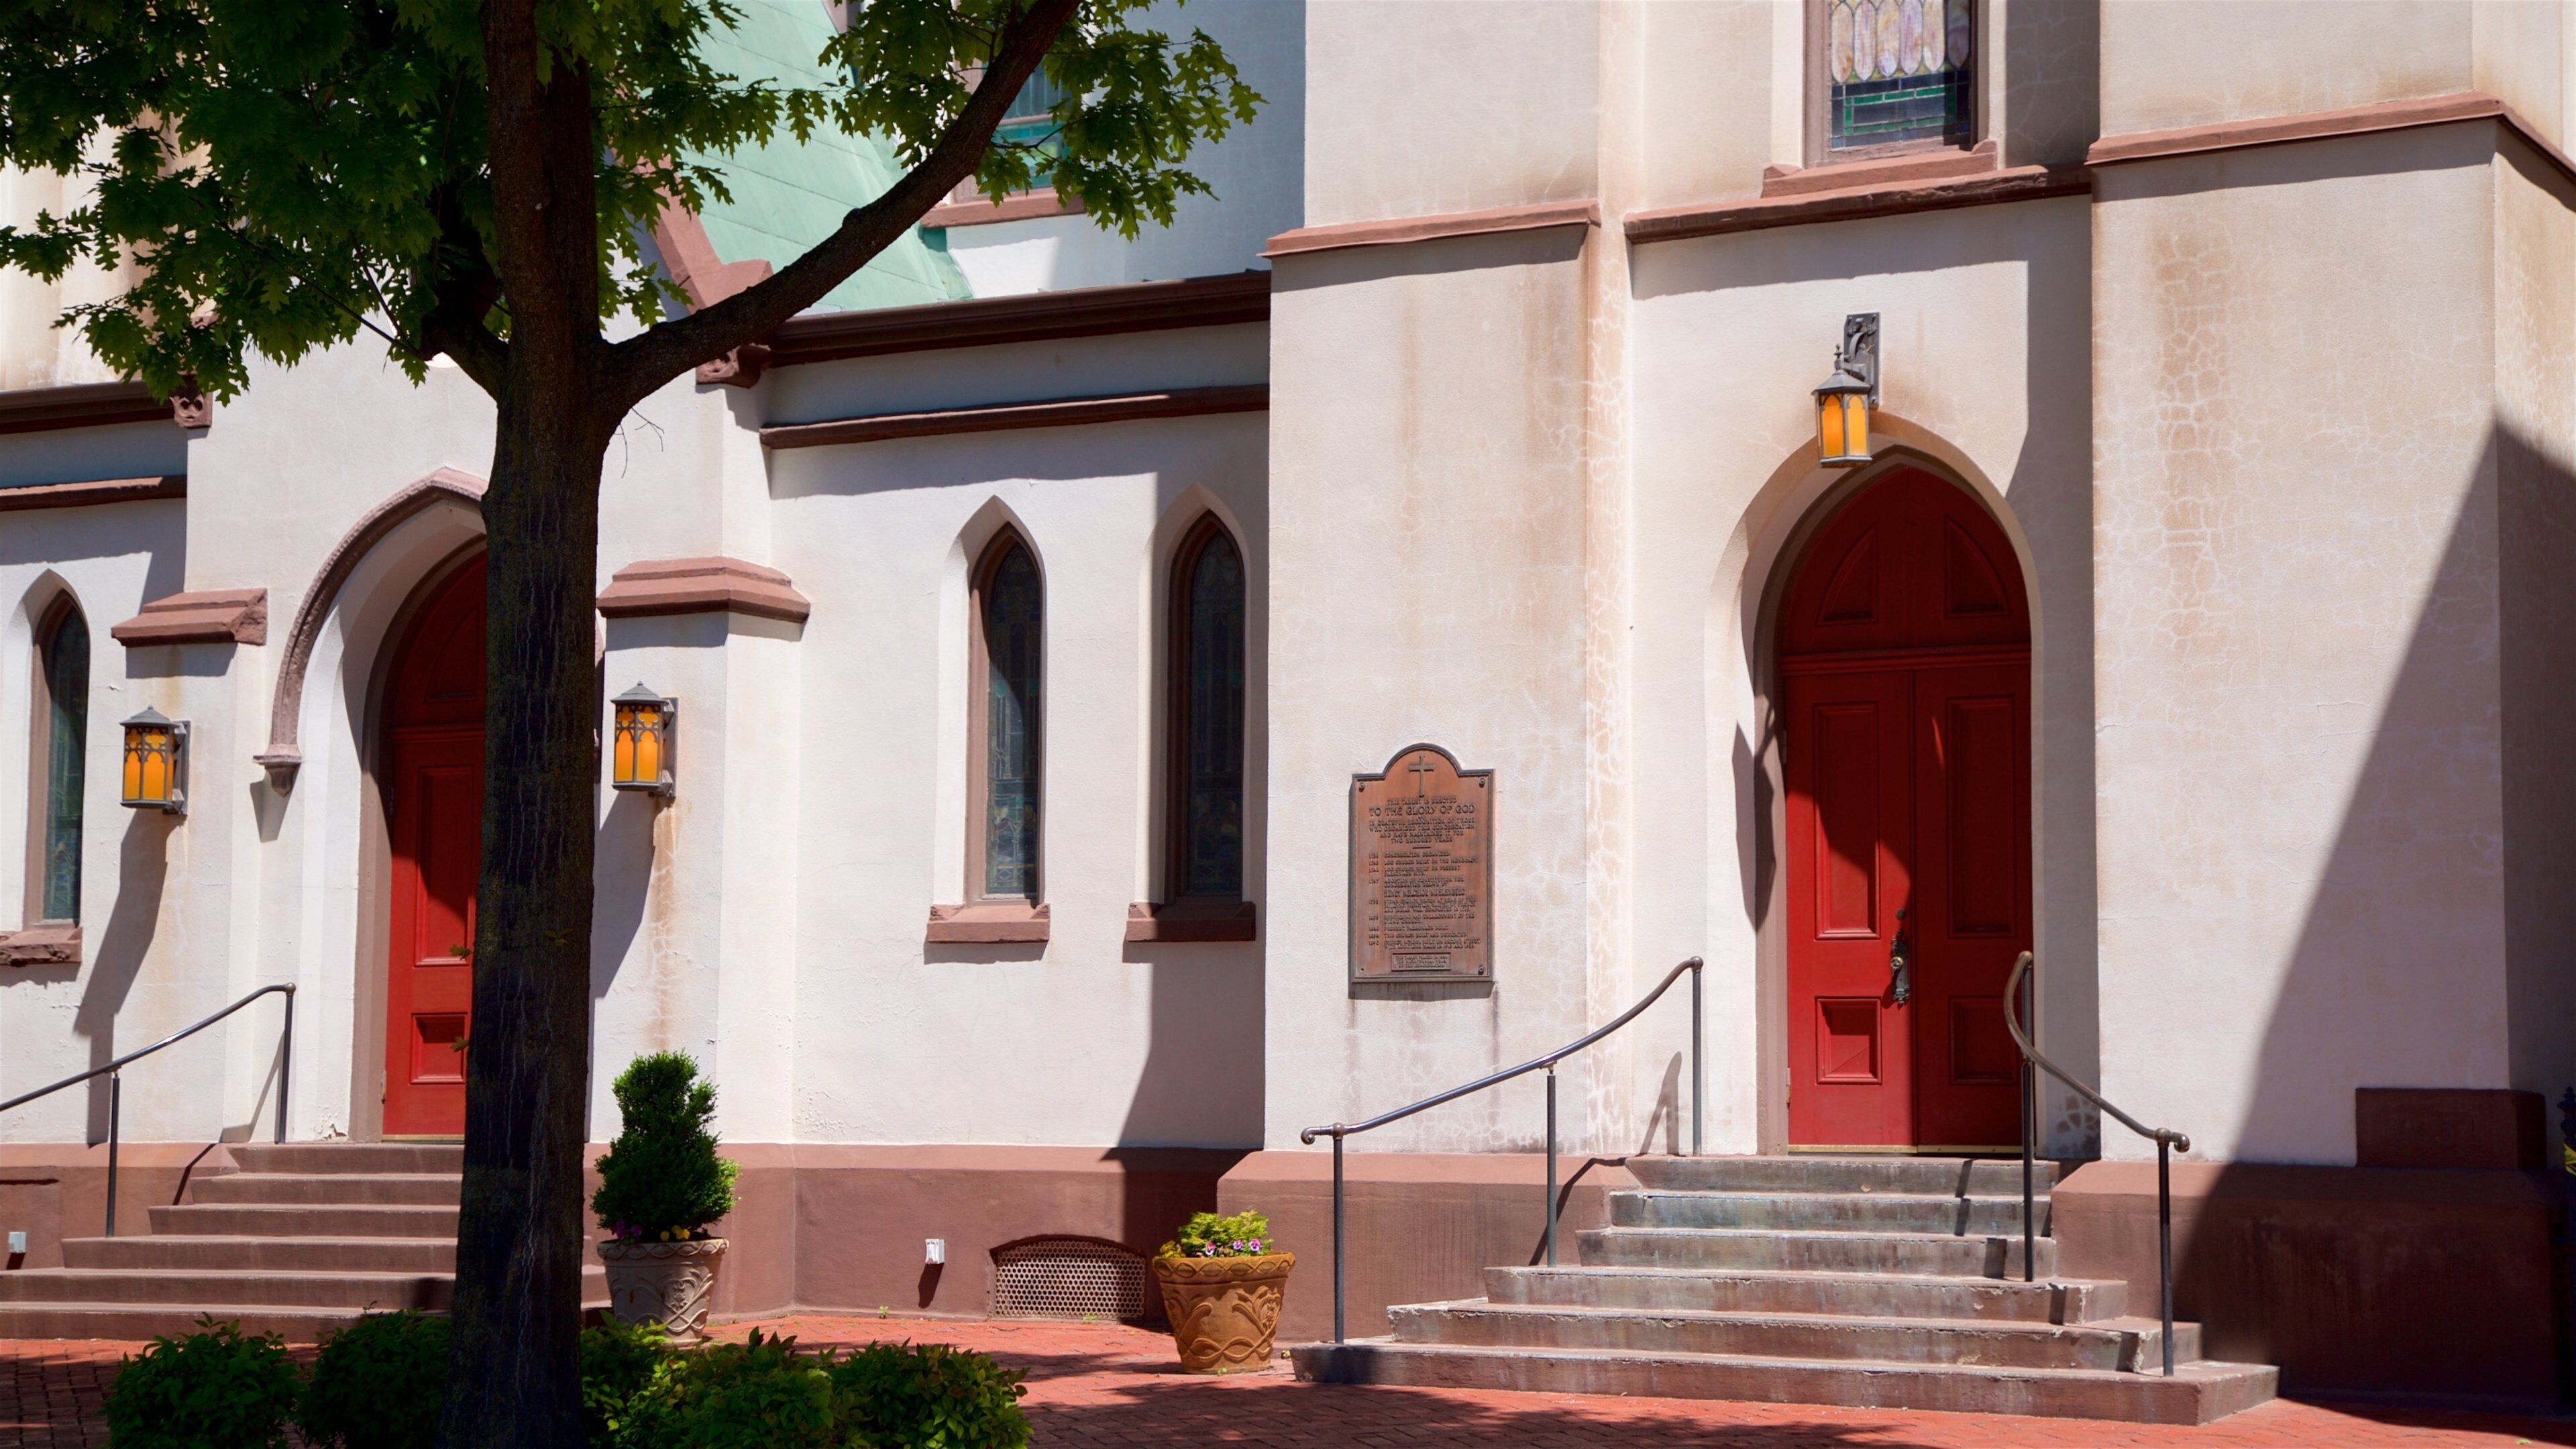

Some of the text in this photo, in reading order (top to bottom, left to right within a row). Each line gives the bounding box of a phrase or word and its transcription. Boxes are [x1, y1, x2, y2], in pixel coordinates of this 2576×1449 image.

[1368, 804, 1475, 816] TO THE GLORY OF GOD
